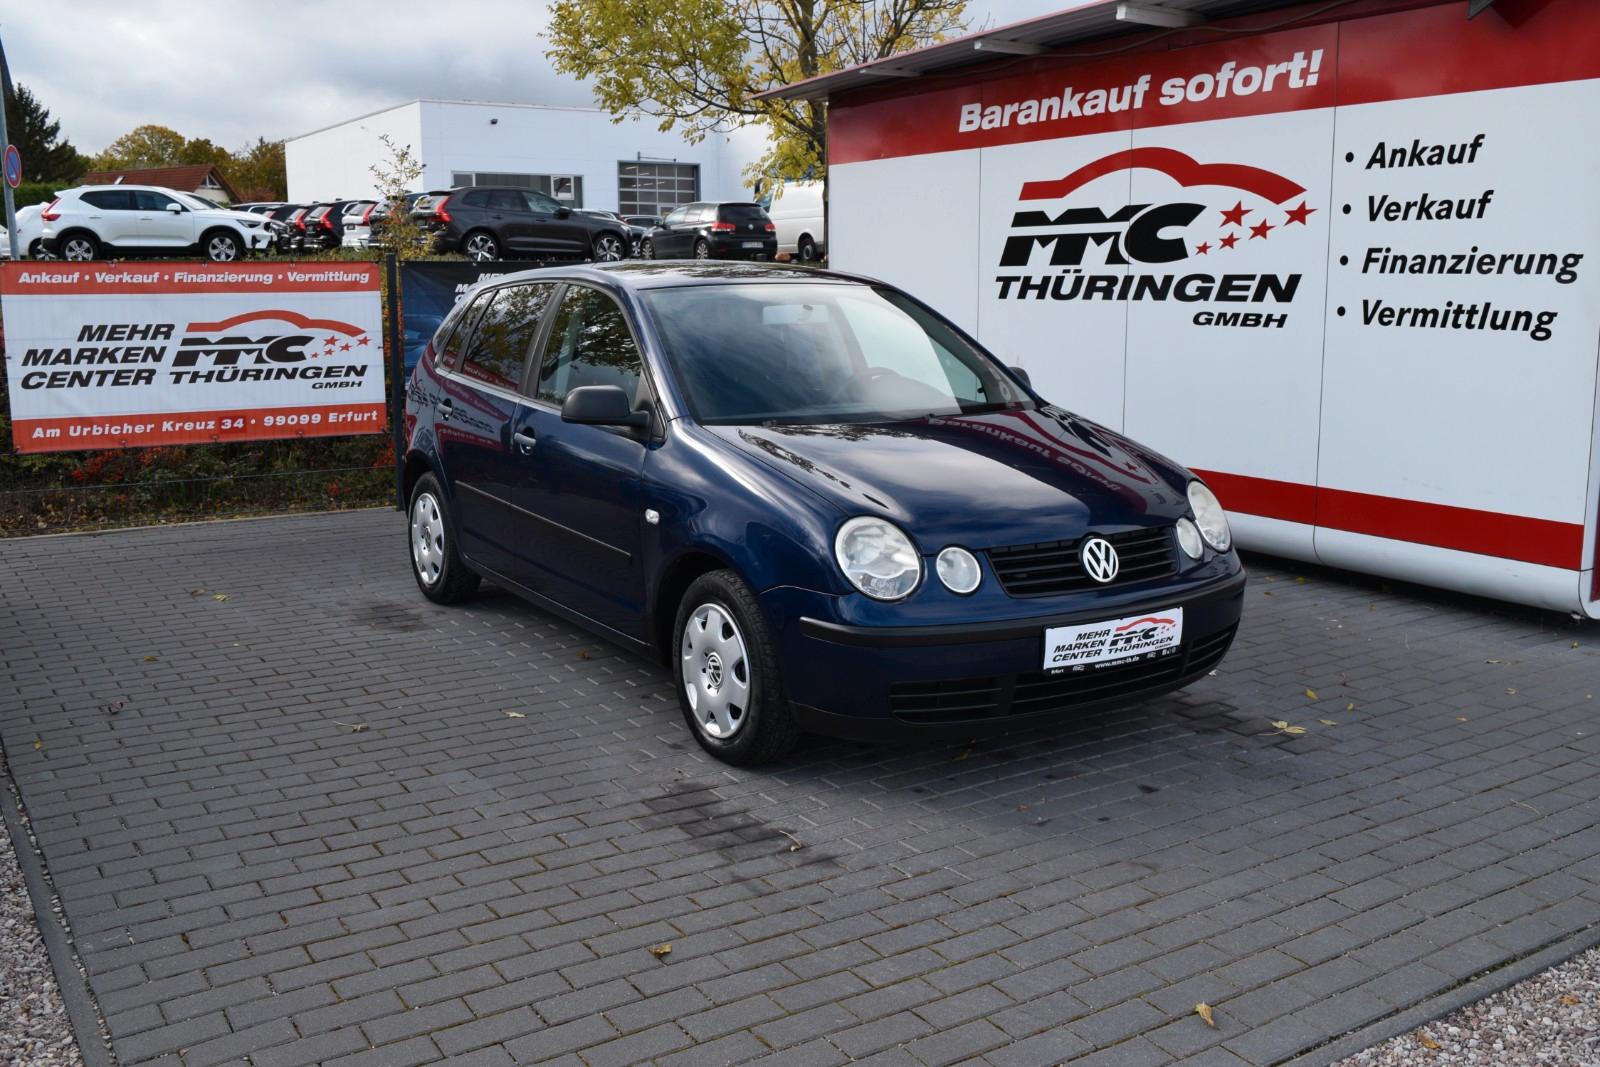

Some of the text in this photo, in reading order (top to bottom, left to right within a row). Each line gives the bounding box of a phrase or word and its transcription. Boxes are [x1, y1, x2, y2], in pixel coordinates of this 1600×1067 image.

[958, 48, 1324, 133] Barankauf sofort!
[1365, 134, 1485, 169] Ankauf
[1368, 190, 1494, 221] Verkauf
[1361, 246, 1584, 284] Finanzierung
[18, 271, 369, 285] Ankauf Verkauf Finanzierung Vermittlung
[995, 269, 1302, 303] THÜRINGEN
[1192, 311, 1288, 328] GMBH
[1362, 299, 1558, 342] Vermittlung
[77, 323, 175, 342] MEHR
[20, 345, 167, 367] MARKEN
[21, 368, 157, 390] CENTER
[169, 365, 368, 385] THÜRINGEN
[311, 381, 363, 390] GMBH
[32, 410, 378, 439] Am Urbicher Kreuz 34 99099 Erfurt
[1075, 628, 1111, 641] MEHR
[1107, 635, 1174, 655] THÜRINGEN
[1052, 649, 1103, 663] CENTER
[1053, 639, 1107, 653] MARKEN
